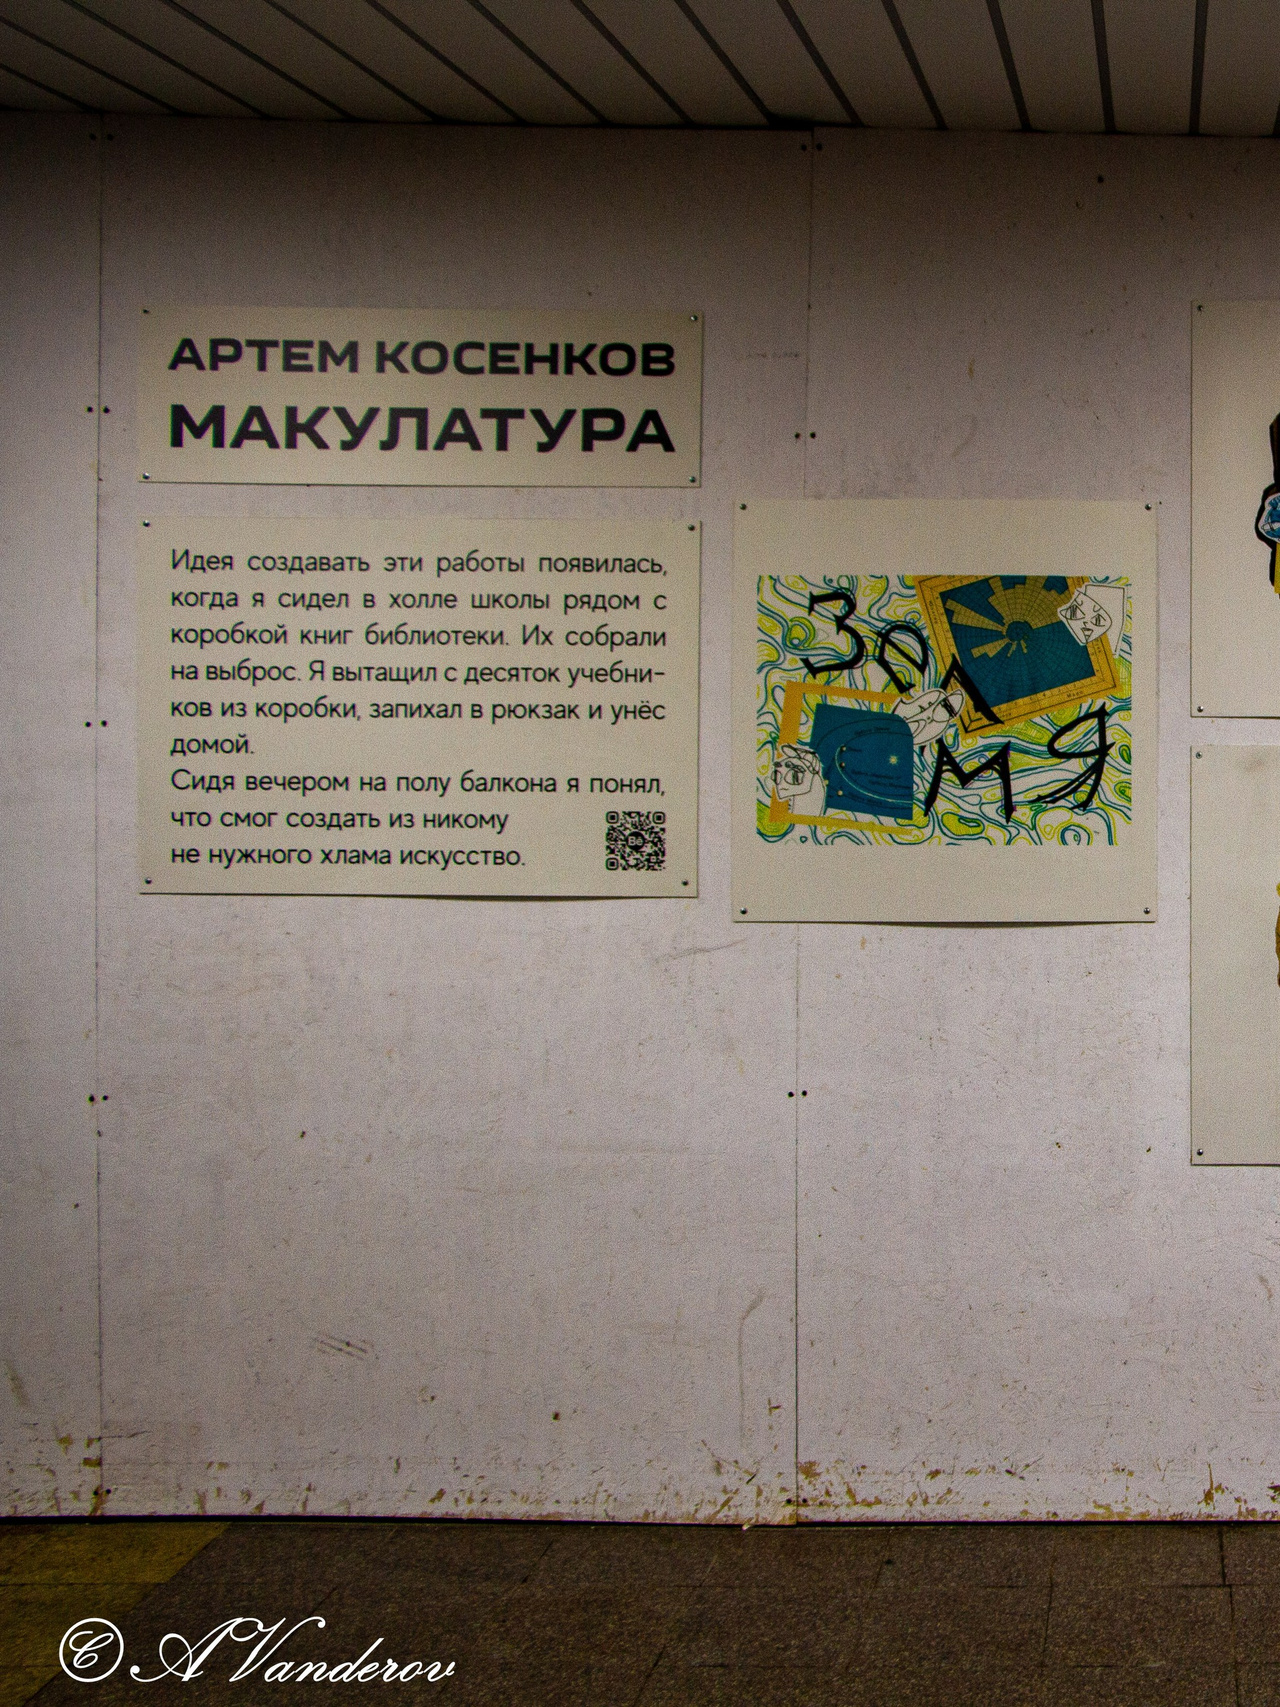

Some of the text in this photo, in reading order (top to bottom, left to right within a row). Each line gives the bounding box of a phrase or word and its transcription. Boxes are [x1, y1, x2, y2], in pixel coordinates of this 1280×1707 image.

[167, 337, 676, 378] АРТЕМ КОСЕНКОВ
[170, 403, 676, 454] МАКУЛАТУРА
[171, 548, 668, 578] Идея создавать эти работы появилась,
[171, 591, 667, 616] когда я сидел в холле школы рядом с
[171, 620, 667, 653] коробкой книг библиотеки. Их собрали
[171, 657, 666, 689] на выброс. Я вытащил с десяток учебни-
[171, 694, 666, 726] ков из коробки, запихал в рюкзак и унёс
[169, 733, 255, 757] домой.
[170, 768, 665, 798] Сидя вечером на полу балкона я понял,
[170, 811, 509, 835] что смог создать из никому
[171, 847, 526, 872] не нужного хлама искусство.
